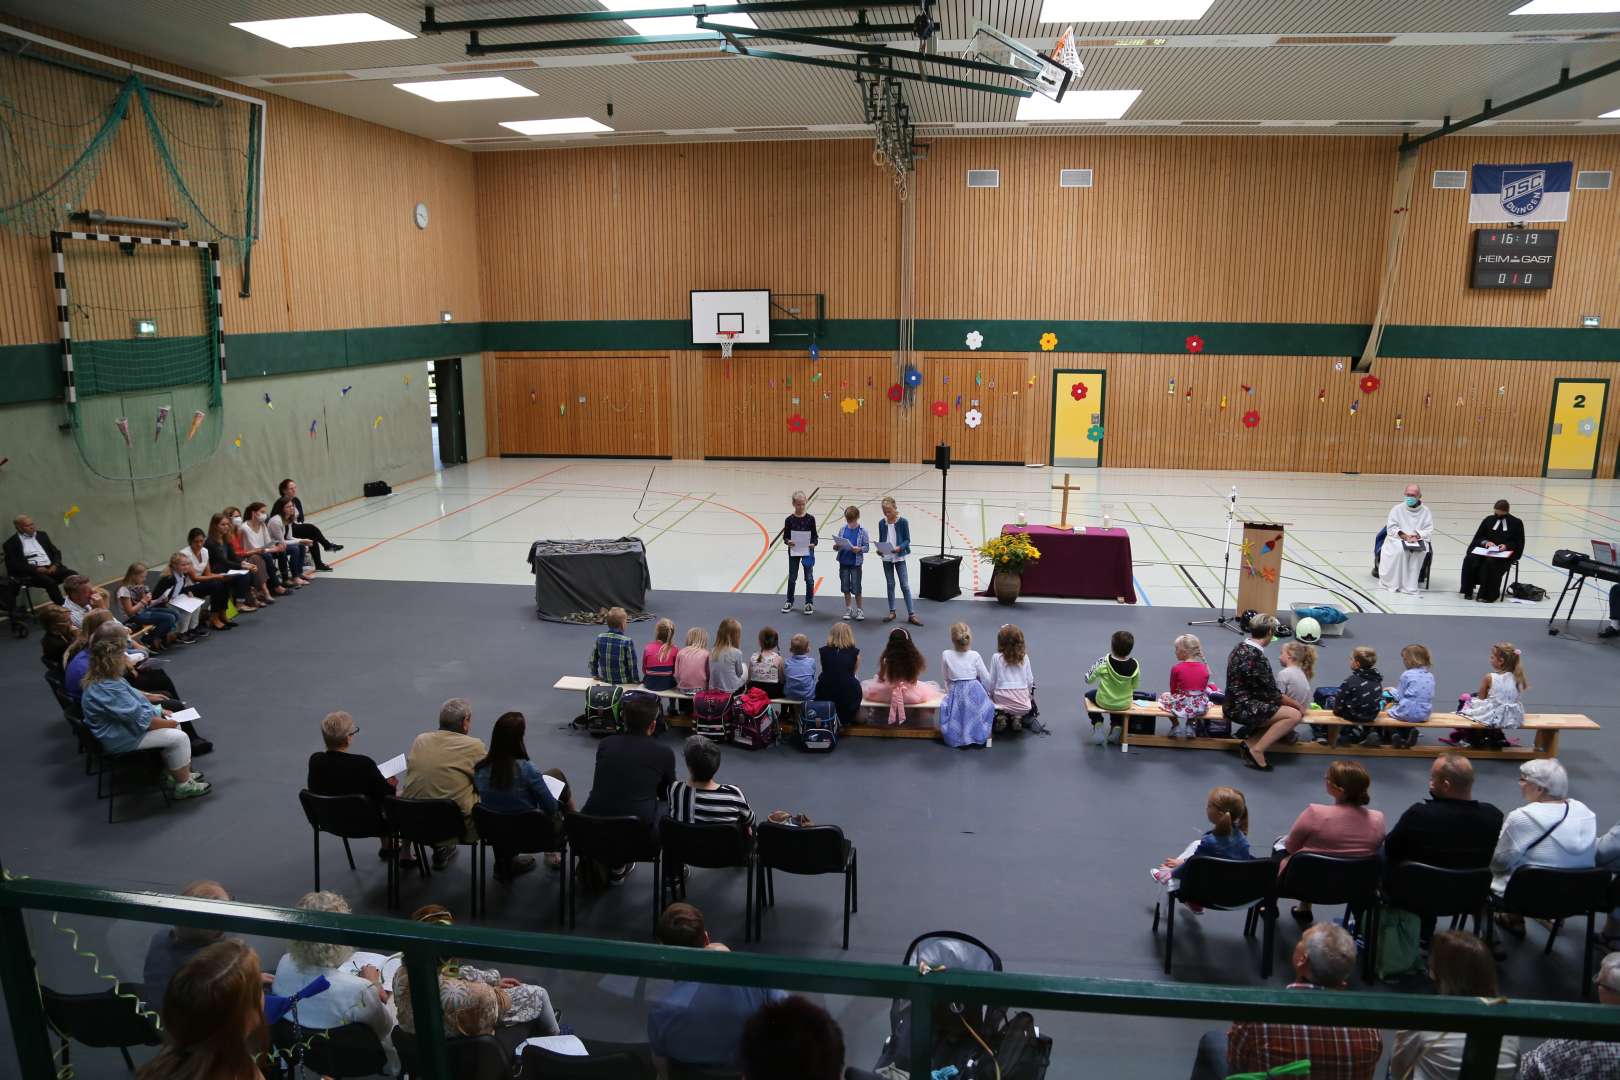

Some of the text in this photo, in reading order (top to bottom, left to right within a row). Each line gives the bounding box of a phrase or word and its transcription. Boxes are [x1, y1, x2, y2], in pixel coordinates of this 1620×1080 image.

[1506, 192, 1541, 214] DUINGEN
[1478, 255, 1553, 263] HEIM GAST
[1498, 273, 1506, 284] 0
[1524, 273, 1532, 284] 0
[1572, 394, 1586, 408] 2
